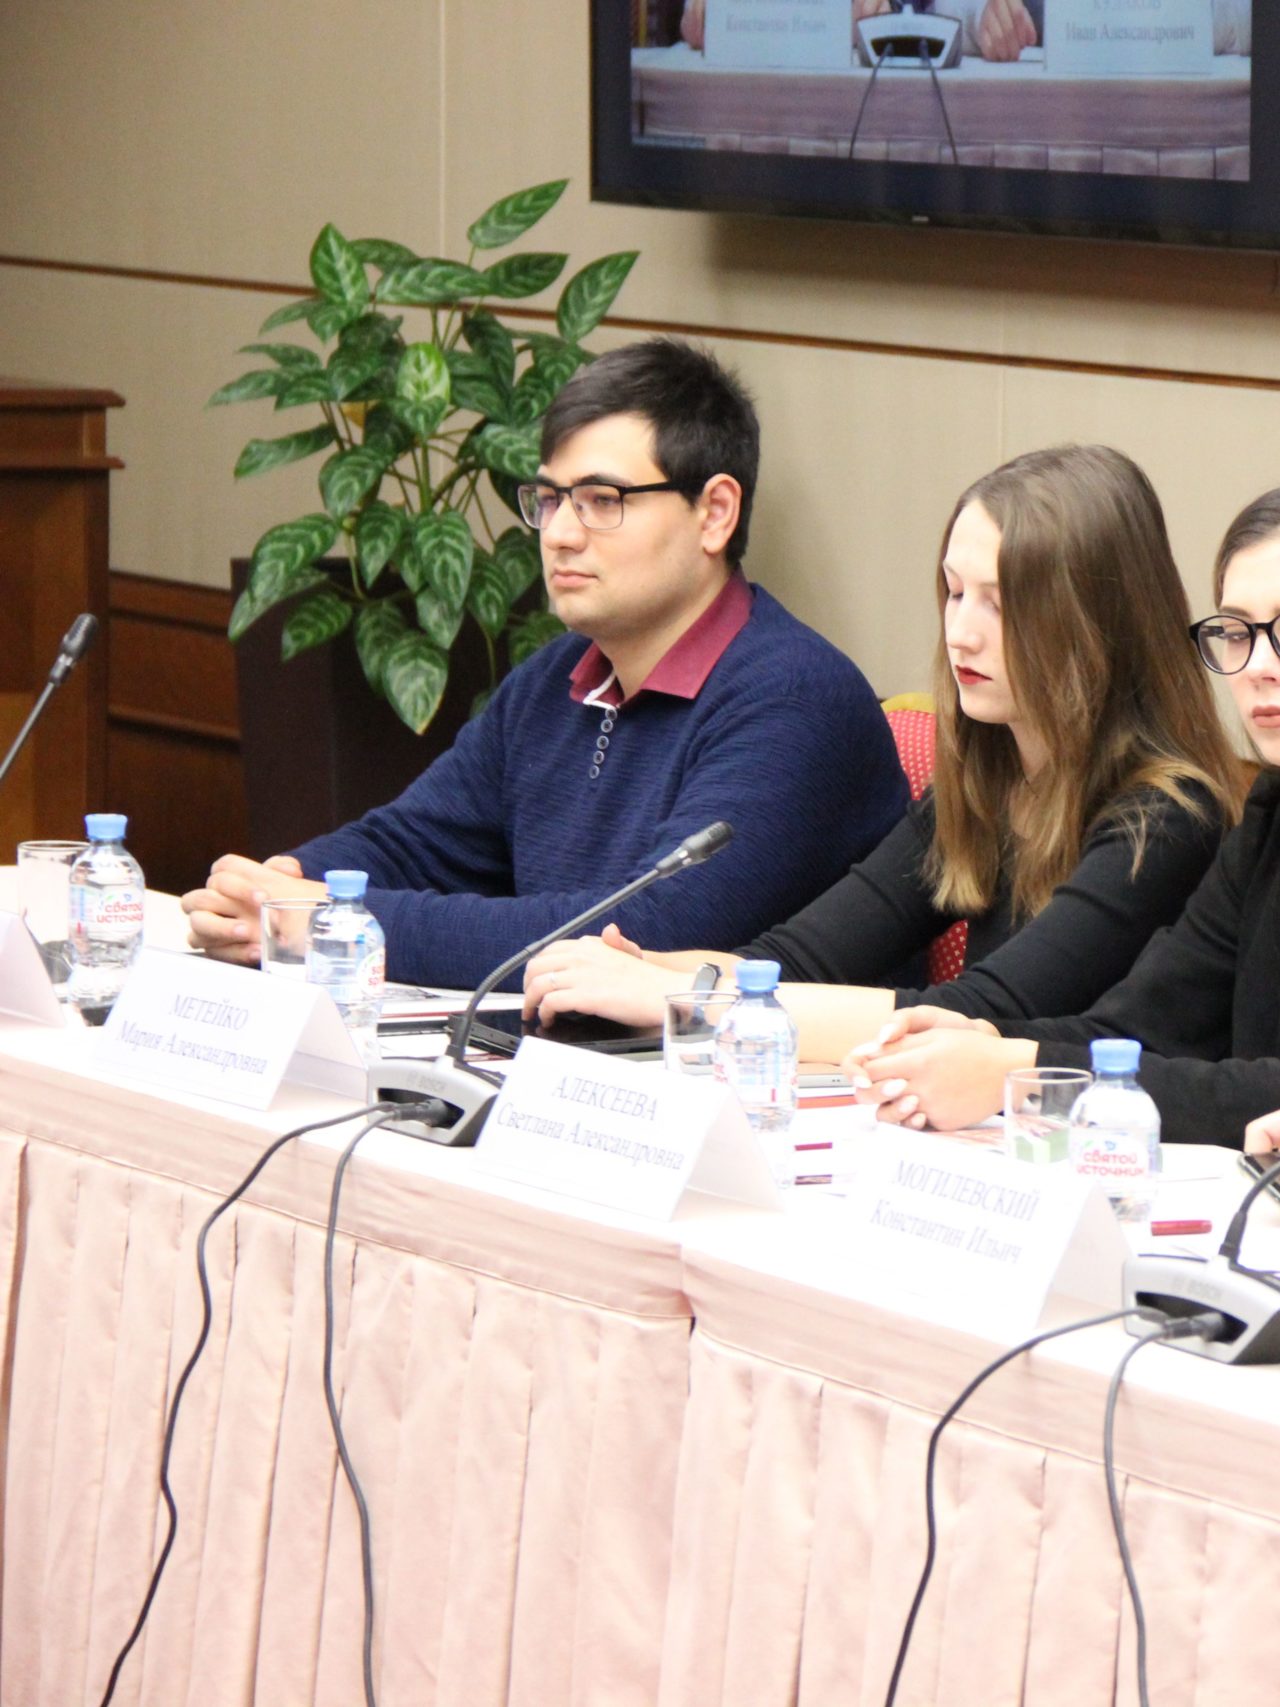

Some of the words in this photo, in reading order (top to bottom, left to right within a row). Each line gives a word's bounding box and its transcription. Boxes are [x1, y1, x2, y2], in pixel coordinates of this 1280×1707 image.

[168, 993, 249, 1031] МЕТЕЙКО
[115, 1020, 164, 1052] Мария
[162, 1032, 268, 1075] Александровна
[551, 1075, 659, 1121] АЛЕКСЕЕВА
[496, 1102, 566, 1140] Светлана
[565, 1121, 685, 1170] Александровна
[889, 1159, 1041, 1222] МОГИЛЕВСКИЙ
[869, 1198, 967, 1249] Константин
[965, 1225, 1023, 1264] Ильич
